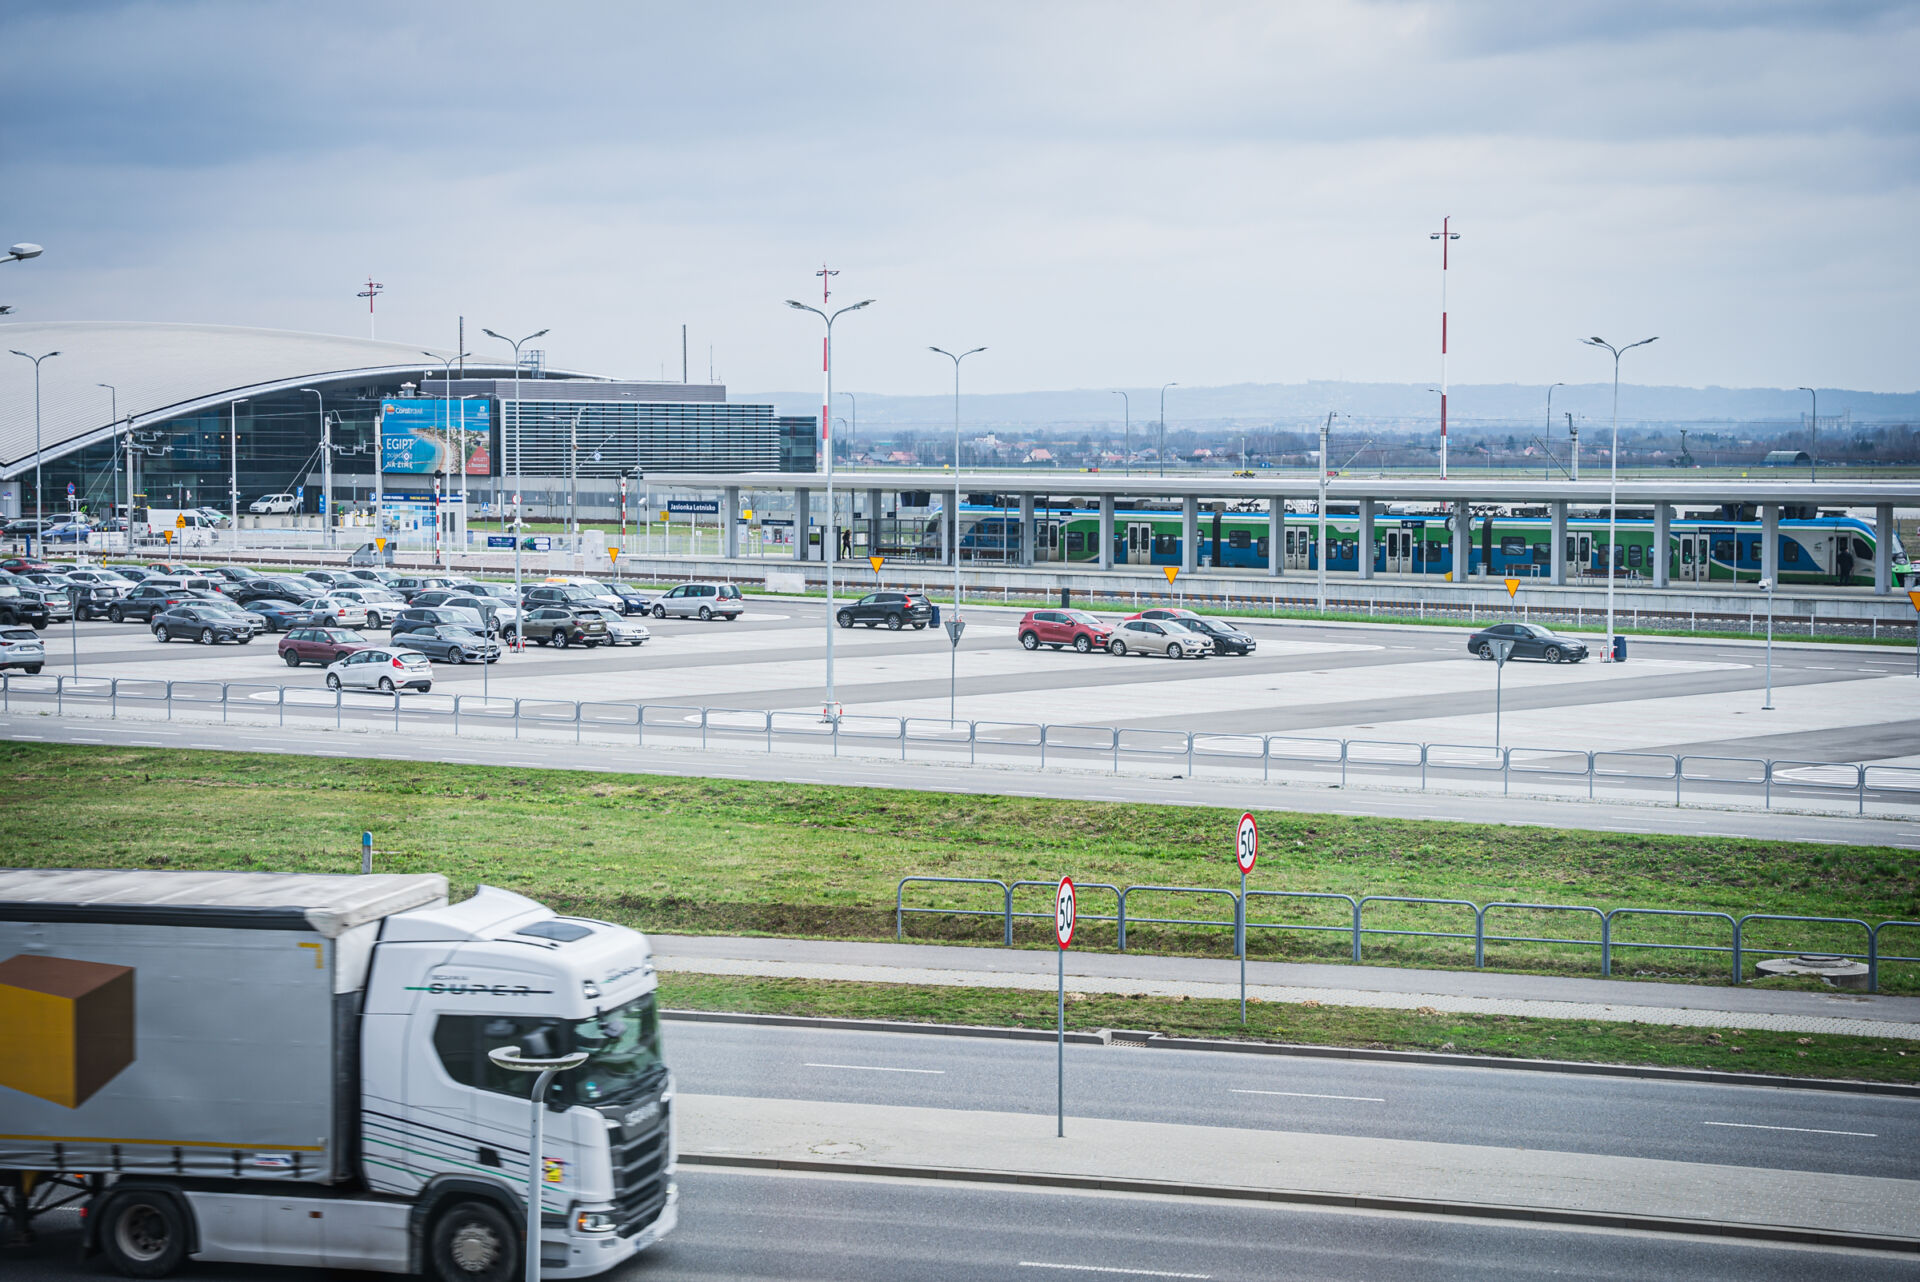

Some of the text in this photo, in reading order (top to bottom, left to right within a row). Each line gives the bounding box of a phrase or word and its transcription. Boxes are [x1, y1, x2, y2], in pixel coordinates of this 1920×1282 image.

[386, 438, 414, 450] EGIPT
[1240, 827, 1255, 859] 50
[1059, 894, 1073, 931] 50
[429, 983, 530, 996] SUPER
